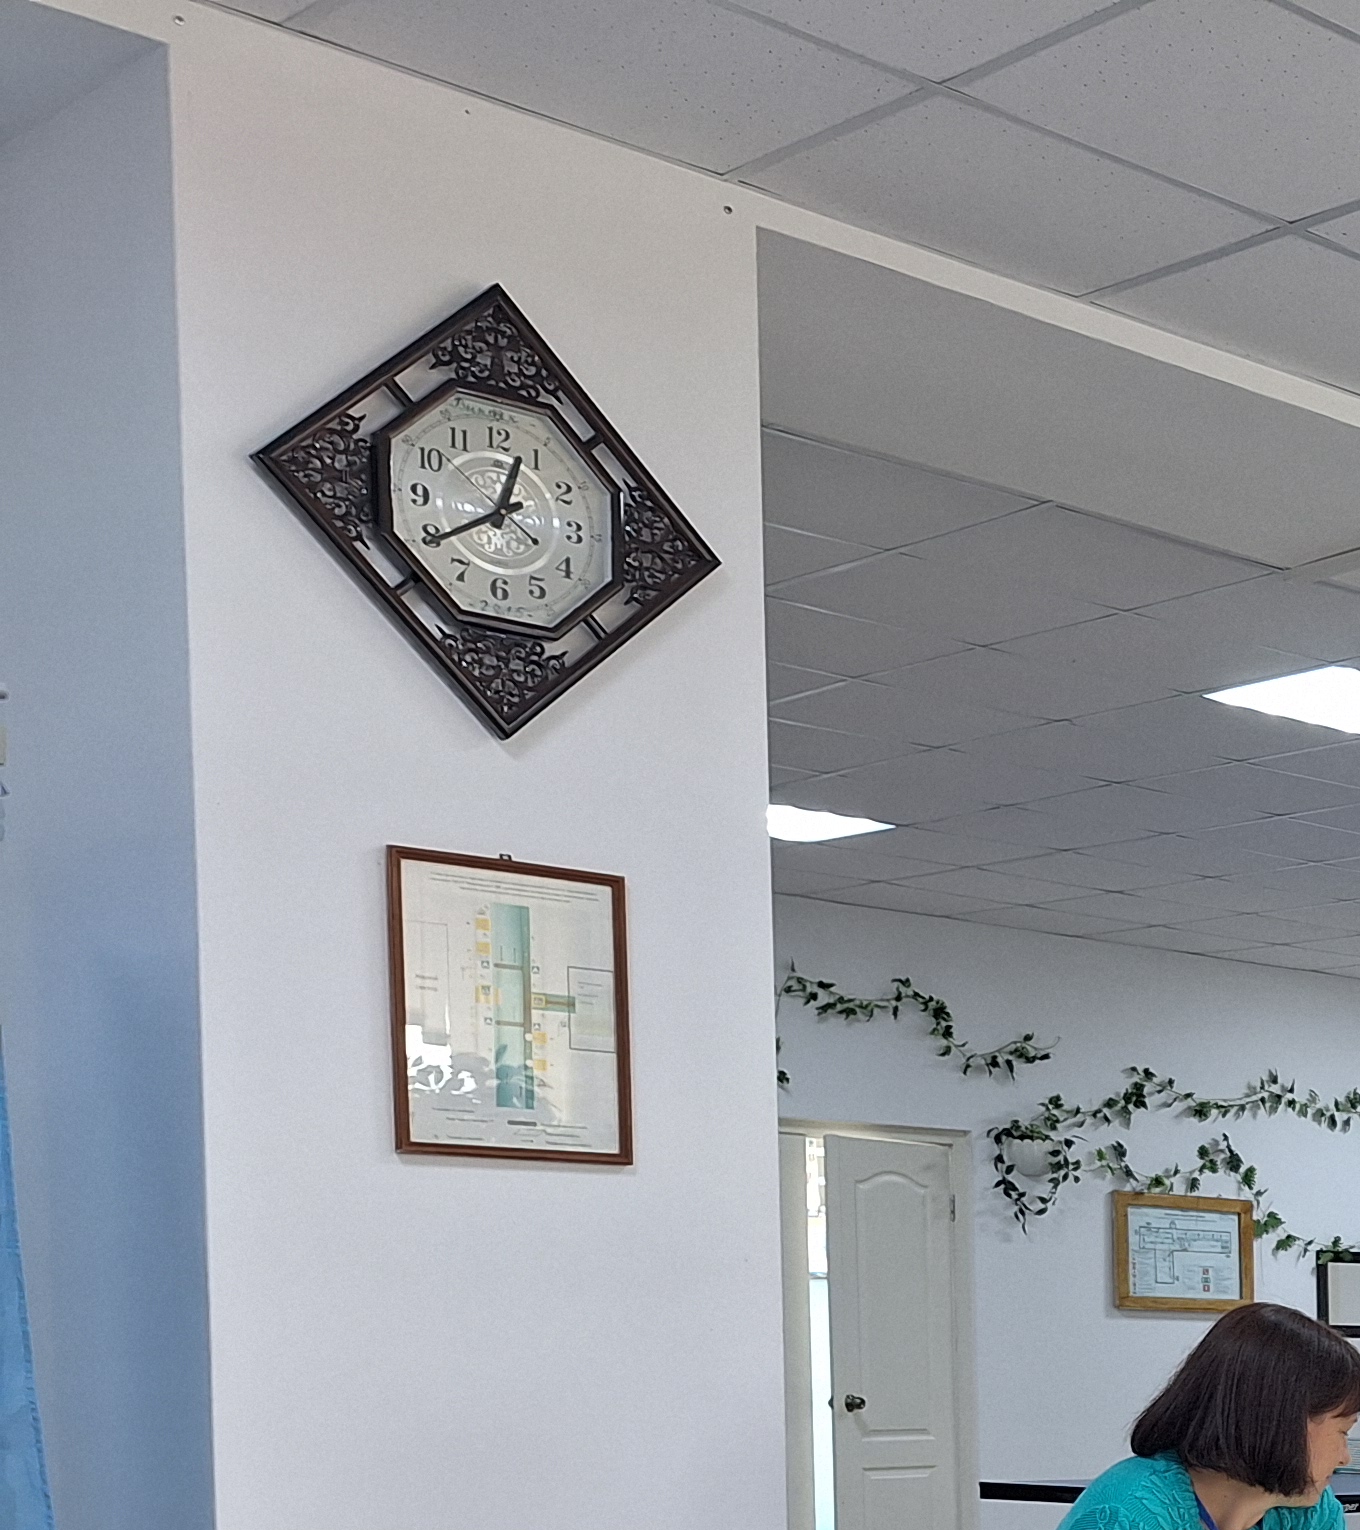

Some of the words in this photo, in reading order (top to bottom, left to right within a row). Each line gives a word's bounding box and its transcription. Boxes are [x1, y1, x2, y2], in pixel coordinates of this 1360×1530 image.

[449, 427, 469, 452] 11
[487, 426, 511, 452] 12
[418, 447, 443, 472] 10
[532, 449, 541, 471] 1
[410, 483, 430, 507] 9
[555, 481, 573, 506] 2
[421, 523, 441, 548] 8
[566, 520, 583, 544] 3
[450, 557, 470, 583] 7
[555, 556, 573, 580] 4
[490, 577, 509, 601] 6
[528, 576, 547, 600] 5
